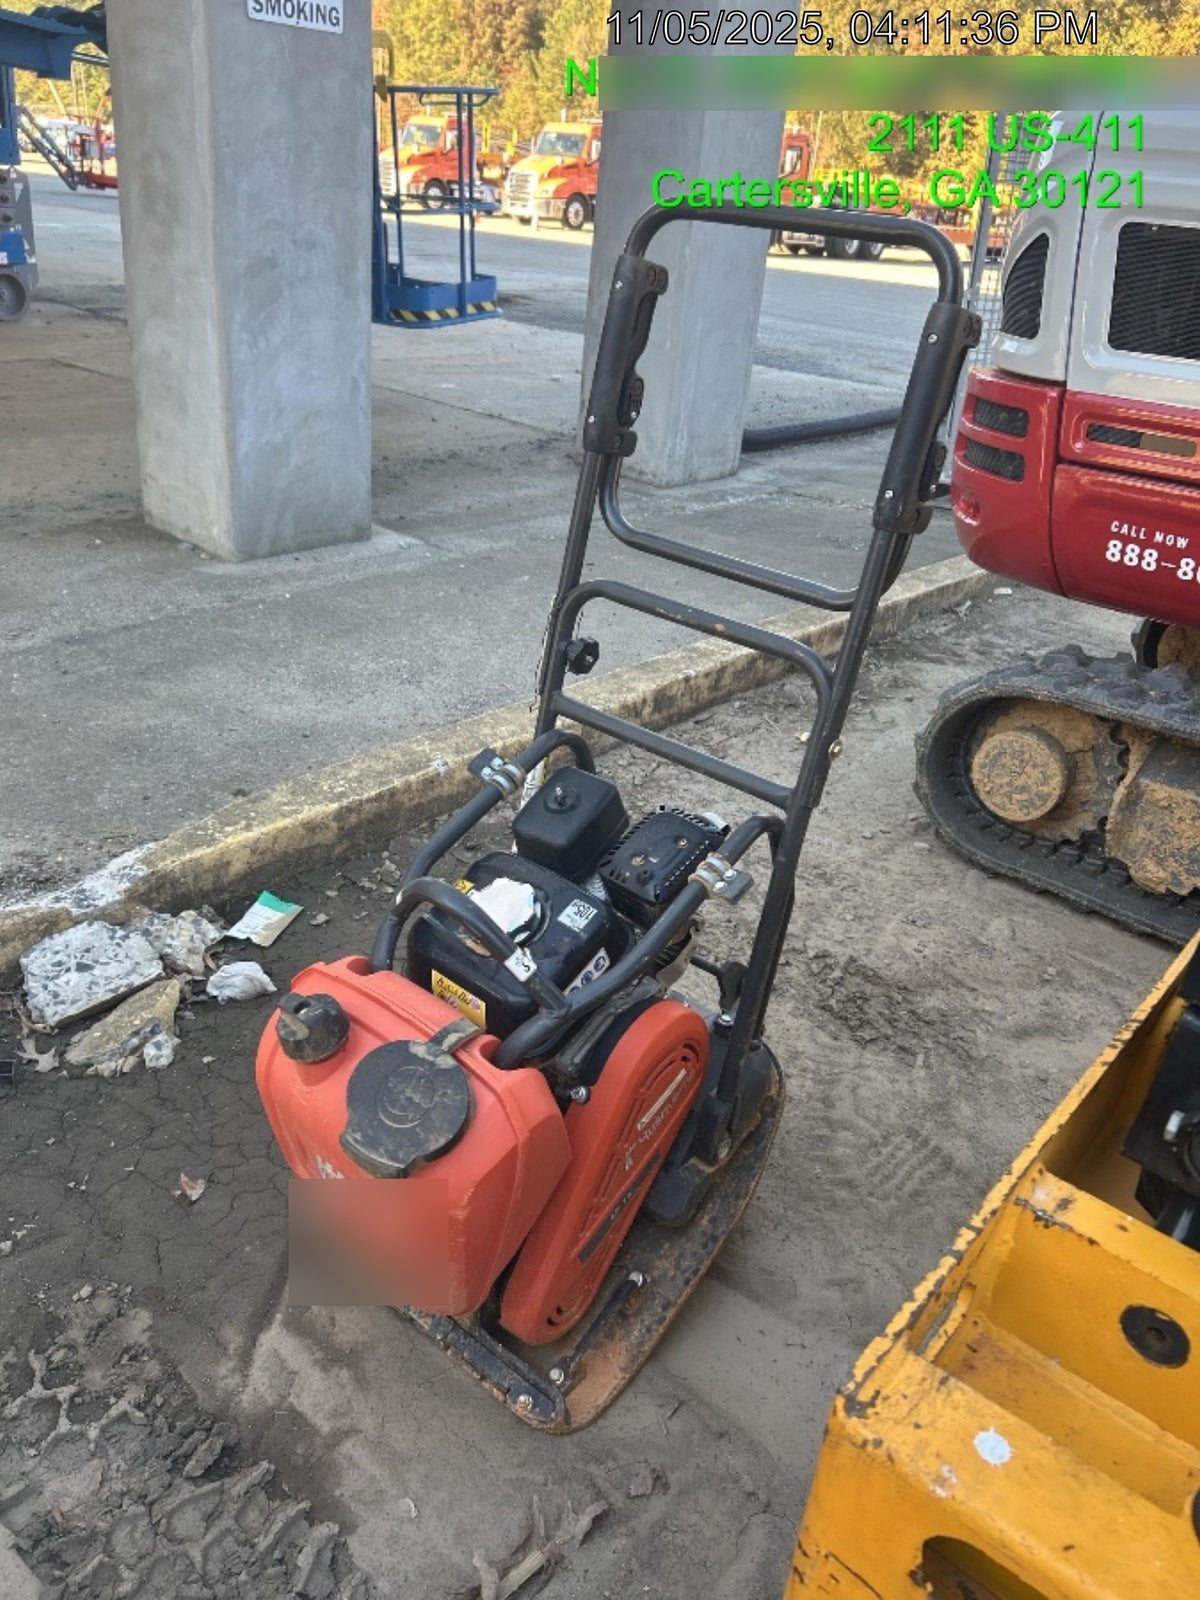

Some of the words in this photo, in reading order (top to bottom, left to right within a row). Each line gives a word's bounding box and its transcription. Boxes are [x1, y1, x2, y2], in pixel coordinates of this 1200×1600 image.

[252, 0, 340, 27] SMOKING
[1110, 520, 1147, 540] CALL
[1153, 530, 1190, 549] NOW
[1105, 539, 1200, 585] 888-8
